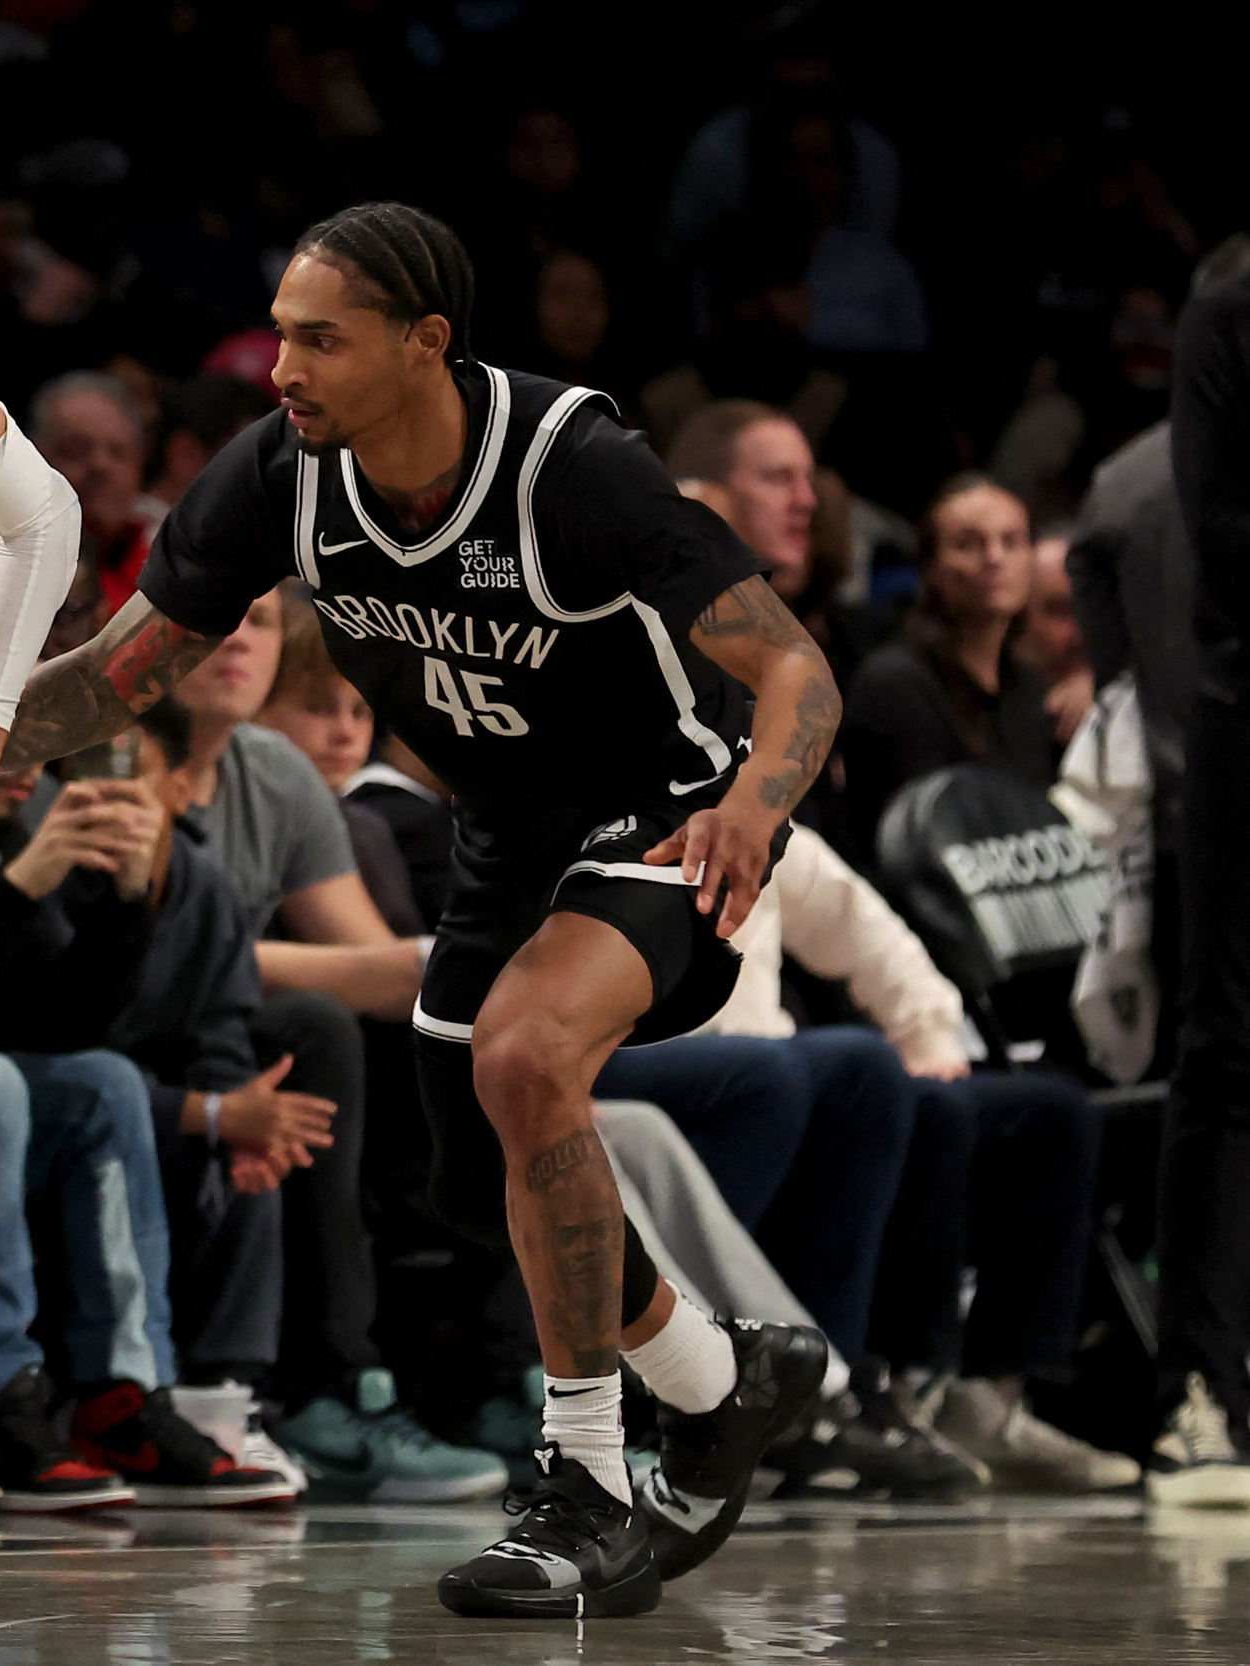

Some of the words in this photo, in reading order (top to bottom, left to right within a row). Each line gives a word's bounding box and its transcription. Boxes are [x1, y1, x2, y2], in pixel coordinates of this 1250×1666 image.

[458, 540, 495, 556] GET
[459, 556, 516, 572] YOUR
[460, 572, 521, 589] GUIDE
[313, 595, 560, 669] BROOKLYN
[423, 655, 530, 738] 45
